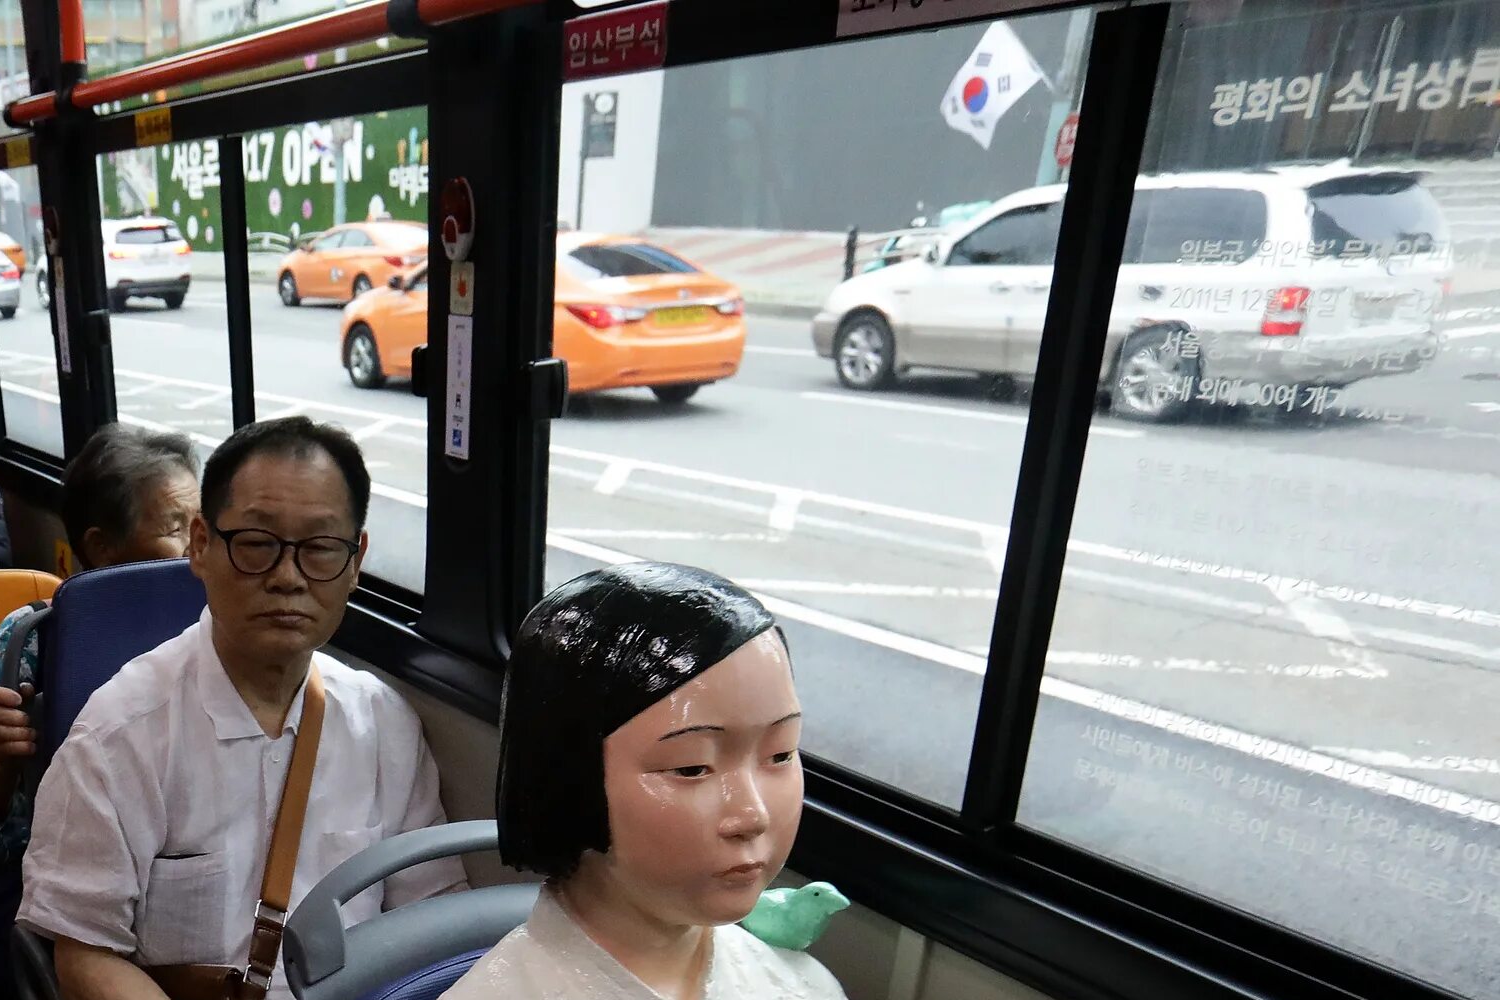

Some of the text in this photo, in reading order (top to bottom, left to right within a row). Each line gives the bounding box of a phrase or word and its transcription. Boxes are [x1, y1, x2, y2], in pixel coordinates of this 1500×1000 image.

[569, 19, 661, 69] 임산부석
[1209, 72, 1325, 127] 평화의
[171, 138, 221, 200] 서울로
[282, 120, 364, 187] OPEN
[1169, 286, 1234, 314] 2011년
[1160, 331, 1201, 359] 서울
